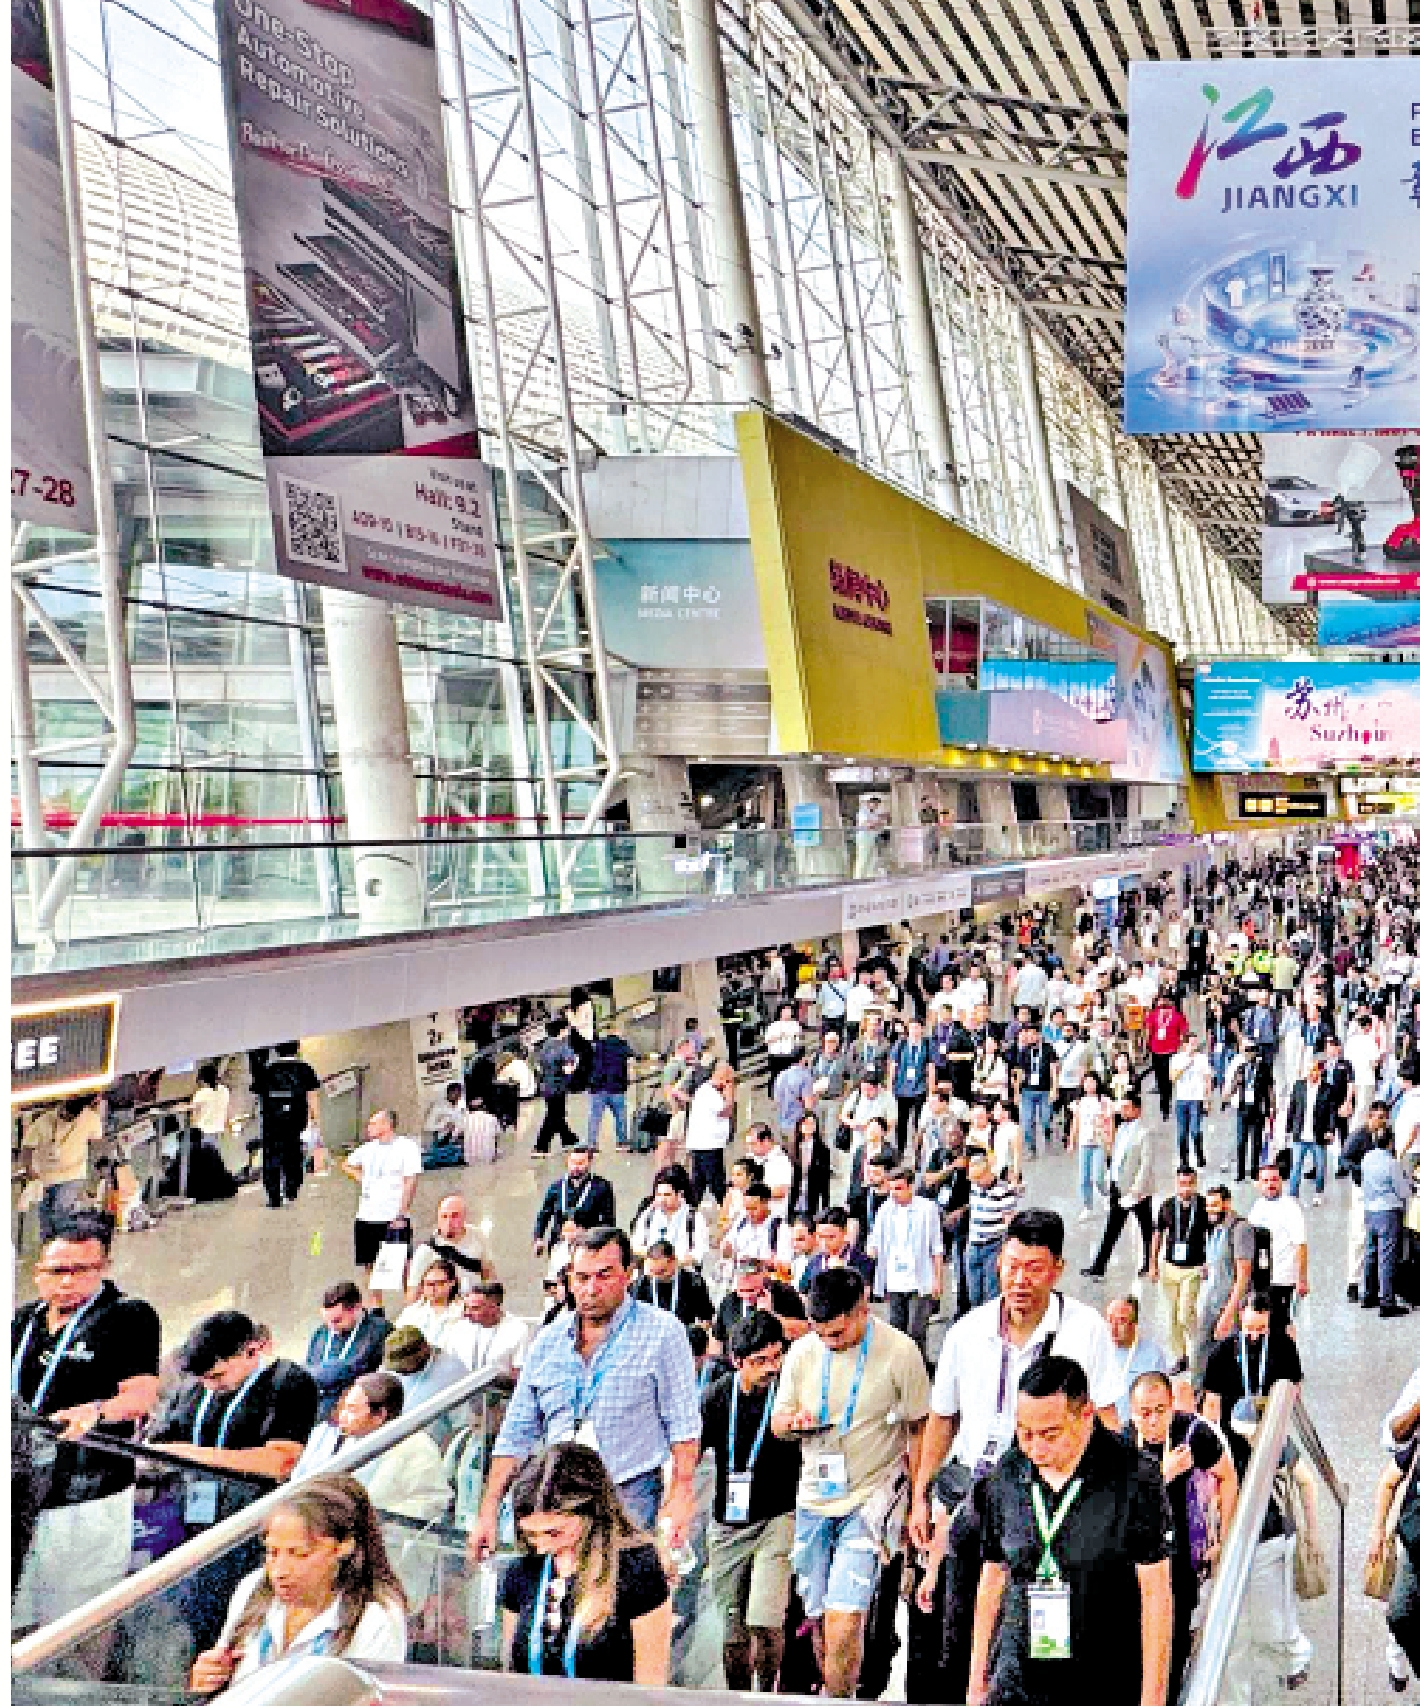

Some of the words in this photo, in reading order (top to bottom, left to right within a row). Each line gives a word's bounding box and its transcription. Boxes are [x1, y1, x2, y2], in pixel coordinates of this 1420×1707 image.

[235, 0, 355, 88] One-Stop
[237, 22, 365, 121] Automotive
[238, 54, 312, 121] Repair
[315, 105, 409, 178] Solutions
[1175, 82, 1363, 200] 江西
[1221, 183, 1359, 213] JIANGXI
[11, 467, 76, 507] 7-28
[637, 606, 673, 619] MEDIA
[640, 583, 721, 604] 新闻中心
